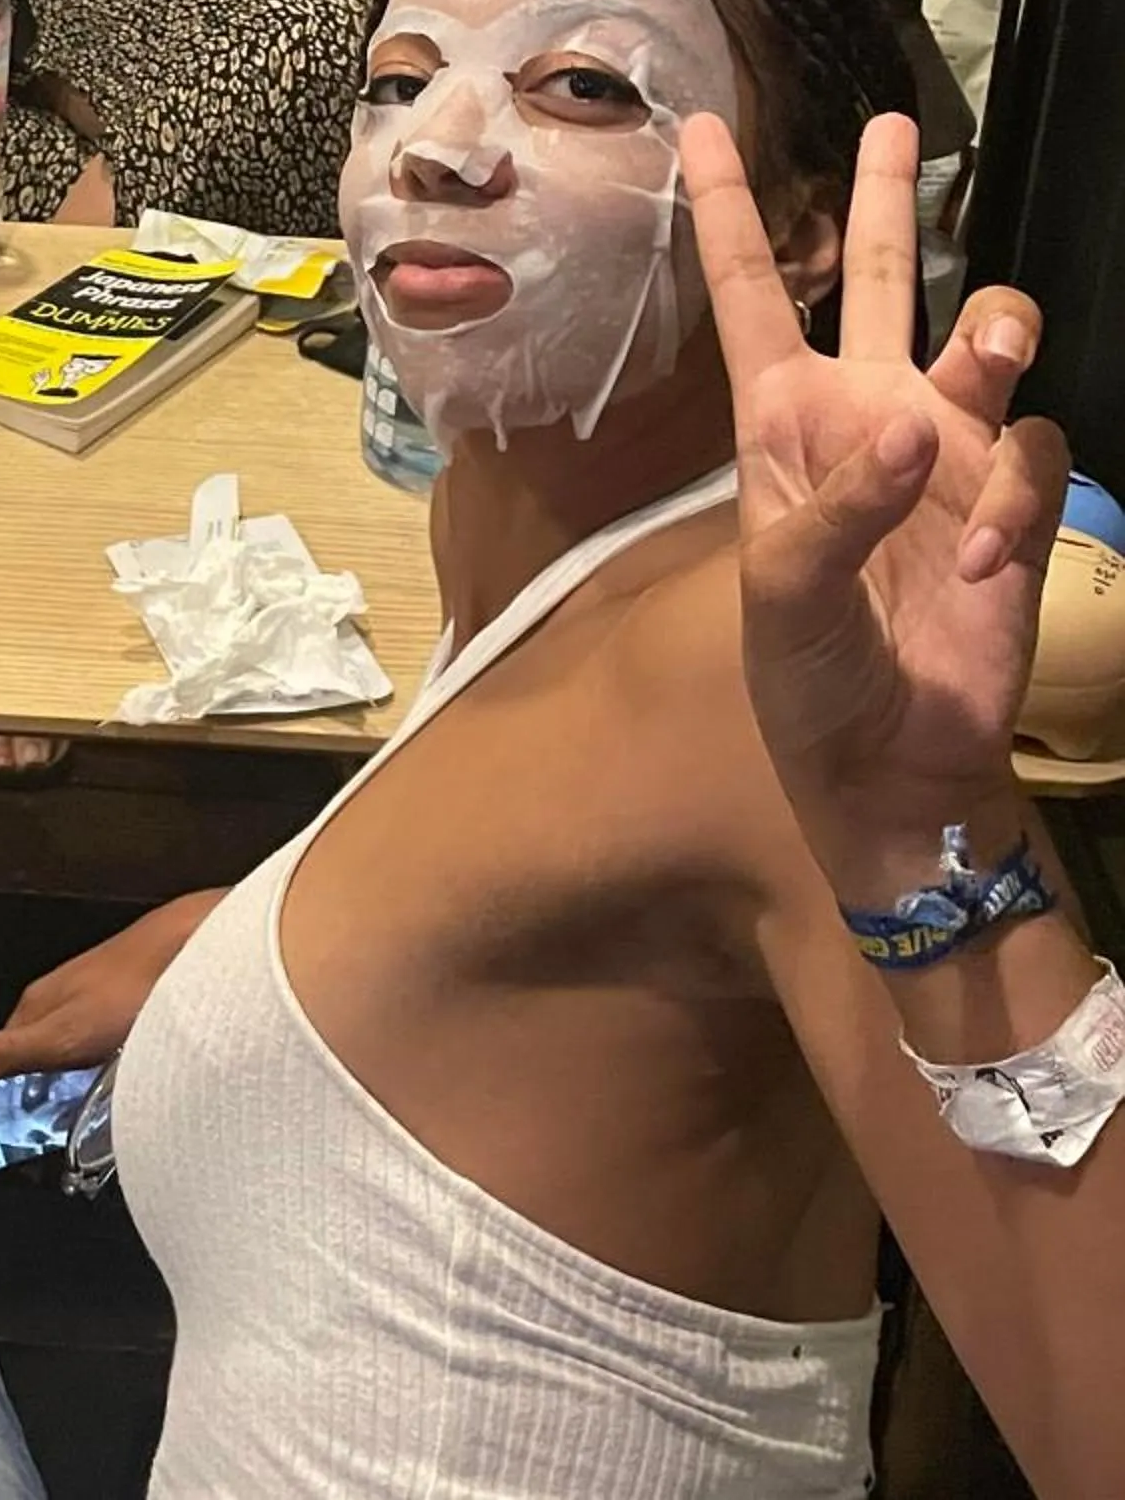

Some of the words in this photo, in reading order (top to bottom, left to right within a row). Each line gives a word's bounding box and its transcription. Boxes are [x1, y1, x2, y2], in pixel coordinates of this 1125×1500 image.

[78, 270, 209, 294] Japanese
[71, 287, 184, 310] Phrases
[30, 303, 173, 330] DUMMIES
